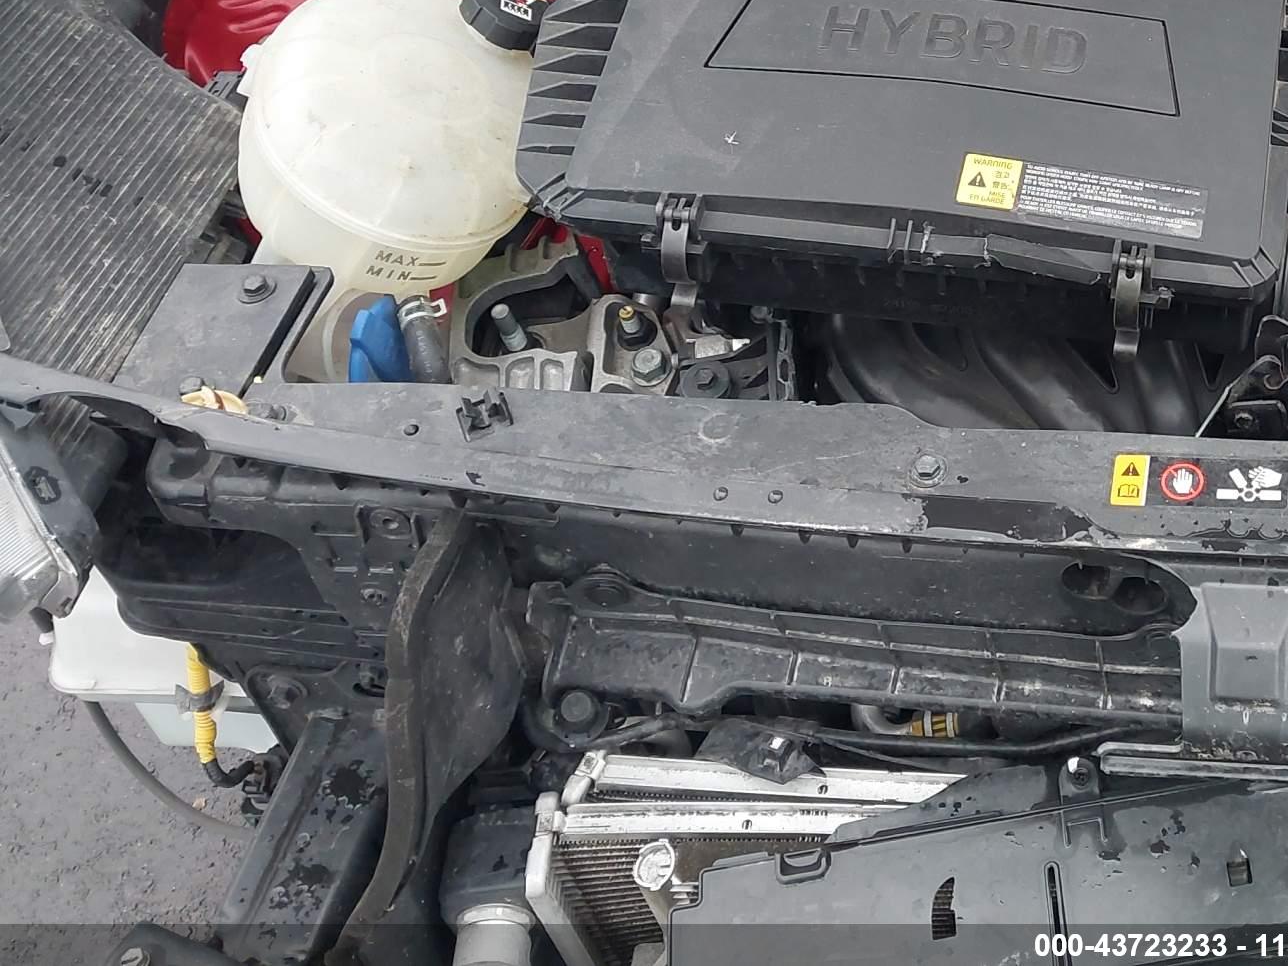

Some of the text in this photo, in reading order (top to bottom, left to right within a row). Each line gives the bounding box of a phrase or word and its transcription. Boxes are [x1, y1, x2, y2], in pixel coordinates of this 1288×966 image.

[816, 6, 1087, 74] HYBRID
[973, 158, 1013, 170] WARNING
[375, 250, 419, 267] MAX
[366, 265, 412, 281] MIN
